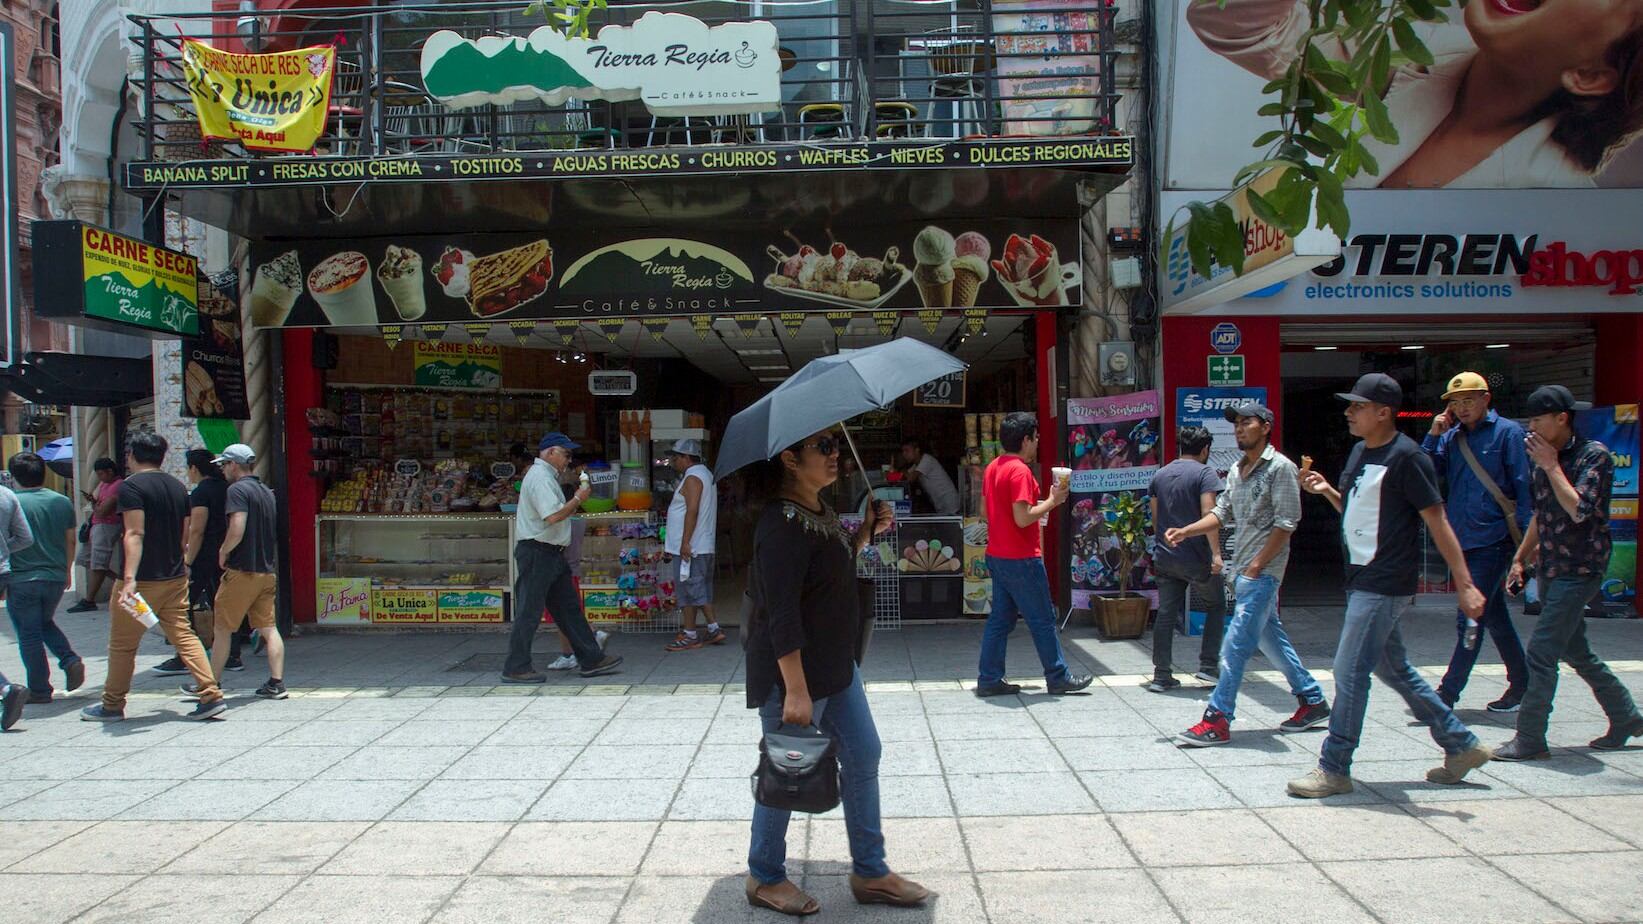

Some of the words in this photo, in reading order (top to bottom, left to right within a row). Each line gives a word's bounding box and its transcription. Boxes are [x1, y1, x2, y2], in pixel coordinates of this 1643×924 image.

[203, 53, 231, 73] CARNE
[232, 55, 258, 74] SECA
[260, 55, 275, 74] DE
[279, 55, 300, 75] RES
[587, 46, 658, 68] Tierra
[664, 44, 733, 71] Regia
[144, 167, 206, 183] BANANA
[211, 165, 249, 181] SPLIT
[273, 164, 328, 180] FRESAS
[331, 162, 364, 177] CON
[368, 160, 422, 176] CREMA
[450, 157, 523, 175] TOSTITOS
[553, 155, 607, 172] AGUAS
[611, 154, 680, 170] FRESCAS
[701, 151, 777, 168] CHURROS
[799, 148, 869, 165] WAFFLES
[891, 148, 944, 164] NIEVES
[970, 145, 1030, 162] DULCES
[1034, 143, 1130, 161] REGIONALES
[86, 228, 148, 264] CARNE
[154, 248, 195, 277] SECA
[640, 261, 686, 275] Tierra
[1520, 241, 1643, 296] shop
[101, 275, 140, 299] Tierra
[672, 274, 713, 290] Regia
[1305, 281, 1414, 298] electronics
[1421, 281, 1512, 298] solutions
[119, 298, 152, 321] Regia
[1217, 333, 1236, 344] ADT
[418, 342, 463, 353] CARNE
[425, 363, 457, 376] Tierra
[1072, 480, 1097, 488] vestir
[1104, 479, 1119, 487] tus
[1074, 471, 1098, 481] Estilo
[1107, 469, 1137, 480] diseño
[320, 593, 340, 618] La
[340, 585, 368, 610] Fama
[383, 597, 394, 609] La
